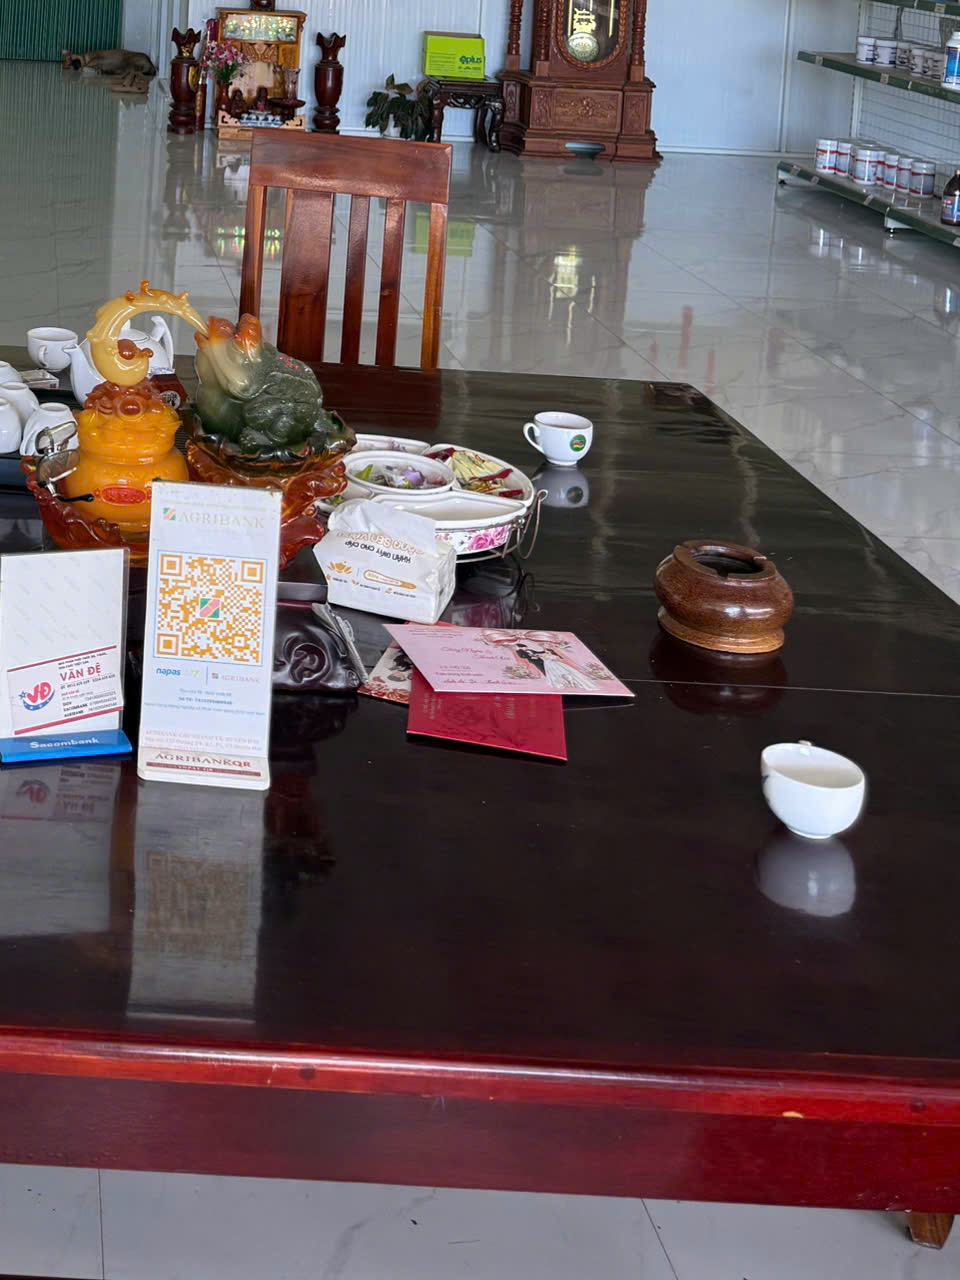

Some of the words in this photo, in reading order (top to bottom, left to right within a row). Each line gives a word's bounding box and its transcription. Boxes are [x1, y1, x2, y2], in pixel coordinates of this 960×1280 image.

[178, 510, 265, 529] AGRIBANK
[60, 667, 84, 681] VĂN
[87, 661, 102, 676] ĐỆ
[156, 667, 181, 676] napas
[29, 737, 99, 749] Sacombank
[155, 753, 251, 767] AGRIBANKQR
